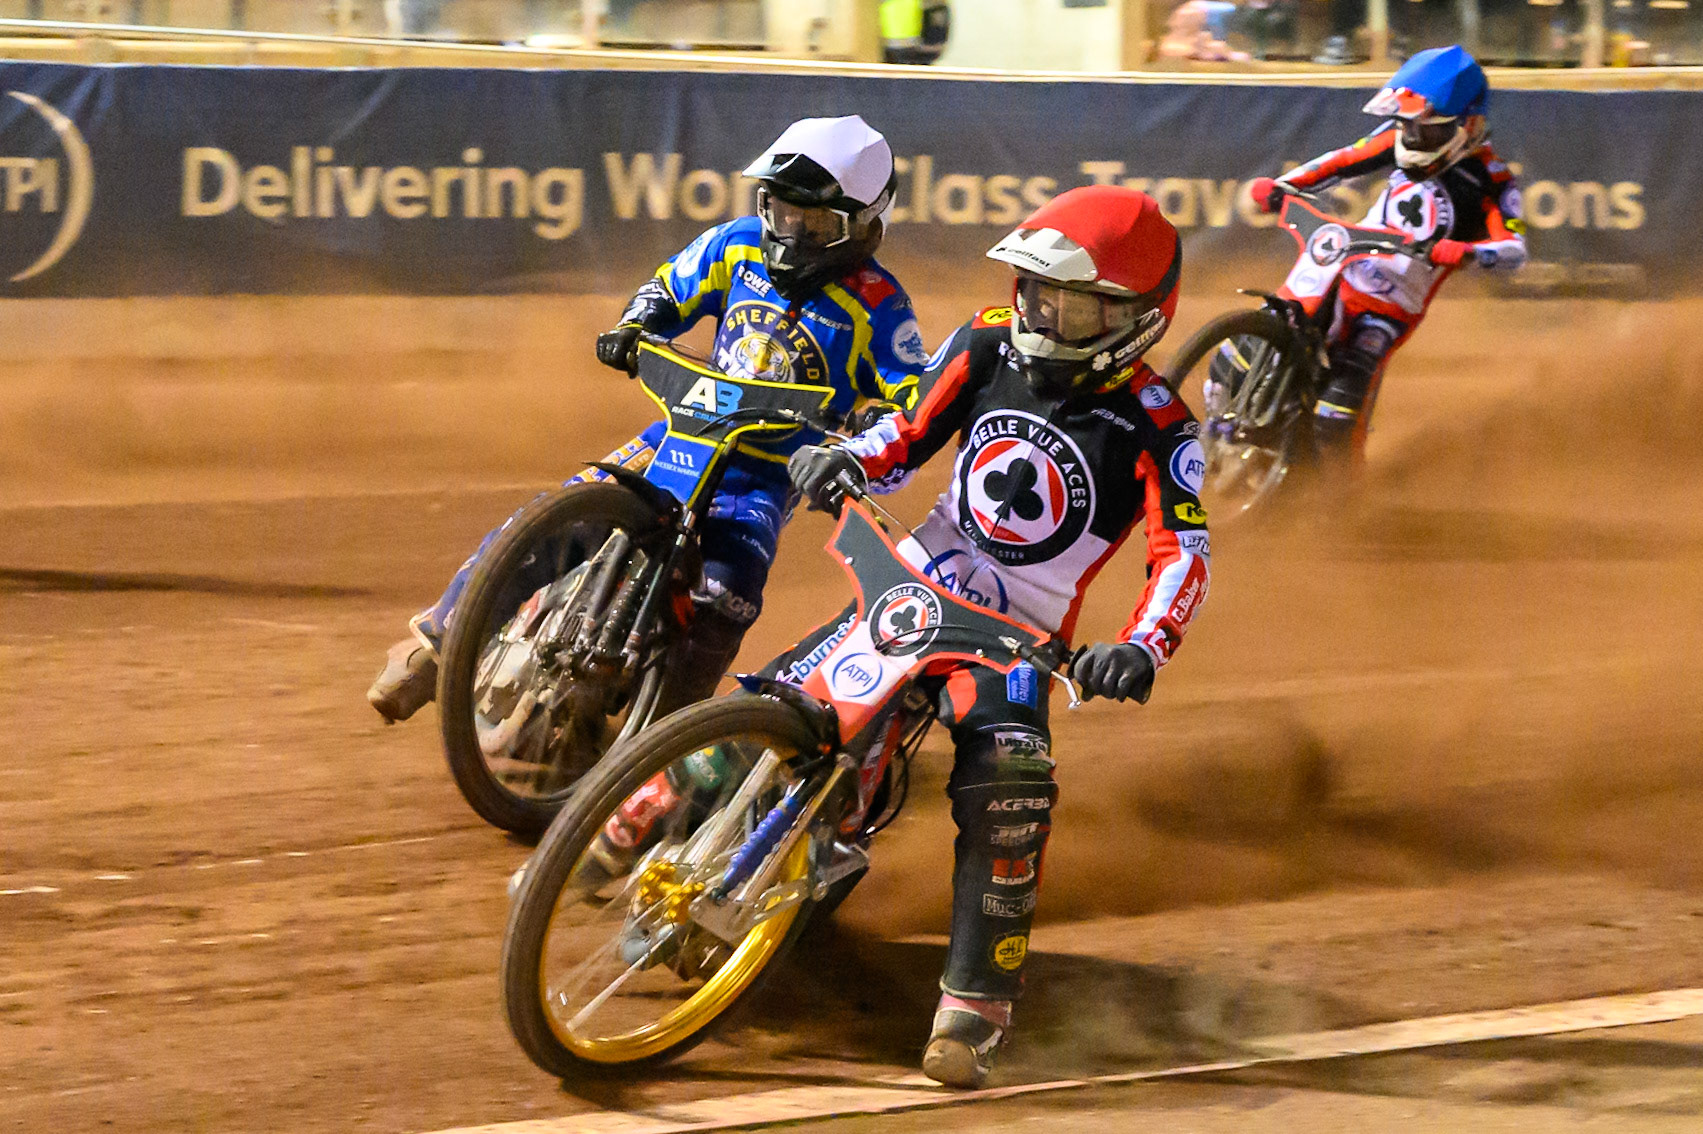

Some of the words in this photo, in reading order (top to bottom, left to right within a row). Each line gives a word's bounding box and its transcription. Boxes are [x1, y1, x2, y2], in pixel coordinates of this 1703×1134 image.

[181, 146, 584, 240] Delivering
[603, 152, 762, 222] Wor
[892, 155, 1058, 225] lass
[726, 309, 820, 380] SHEFFIELD
[671, 405, 695, 417] RACE
[680, 377, 744, 417] AB
[972, 419, 1018, 449] BELLE
[1028, 424, 1064, 456] VUE
[1061, 462, 1087, 508] ACES
[916, 589, 931, 604] VUE
[841, 663, 873, 687] ATPI
